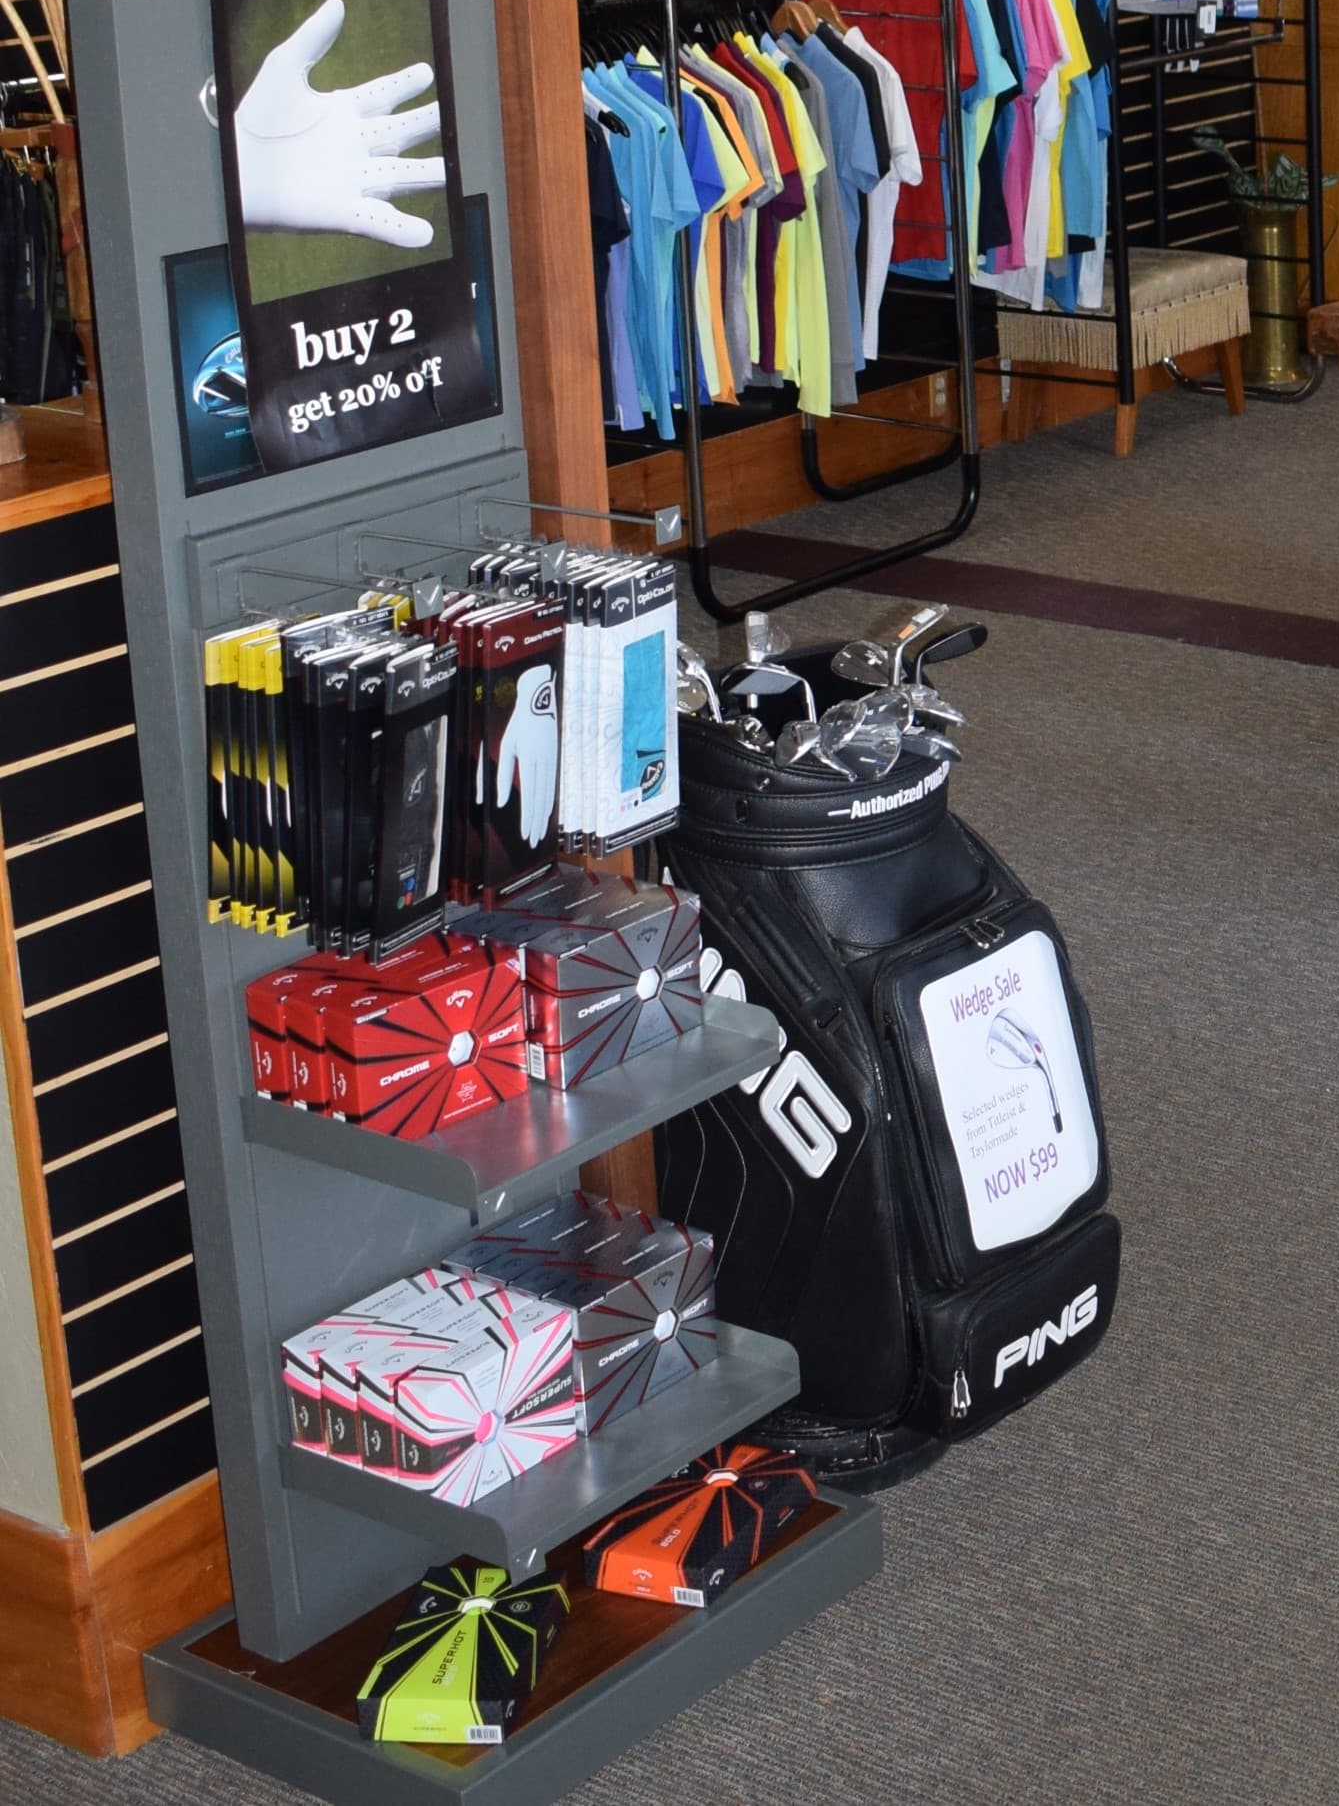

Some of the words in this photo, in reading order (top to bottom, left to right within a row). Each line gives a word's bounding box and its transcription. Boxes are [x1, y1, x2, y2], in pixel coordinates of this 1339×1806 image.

[290, 318, 379, 370] buy
[389, 309, 416, 344] 2
[288, 392, 336, 433] get
[338, 371, 401, 412] 20%
[405, 356, 443, 393] off
[849, 780, 923, 820] Authorized
[577, 993, 622, 1019] CHROME
[950, 985, 995, 1023] Wedge
[994, 968, 1022, 1000] Sale
[488, 1024, 520, 1043] SOFT
[379, 1060, 430, 1086] CHROME
[962, 1094, 997, 1123] Selected
[966, 1123, 987, 1142] from
[1018, 1103, 1027, 1115] &
[984, 1158, 1026, 1203] NOW
[1029, 1142, 1059, 1181] $99
[682, 1298, 709, 1319] SOFT
[598, 1339, 640, 1368] CHROME
[994, 1284, 1098, 1388] PING
[512, 1374, 572, 1420] SUPERSOFT
[660, 1529, 681, 1547] BOLD
[432, 1630, 468, 1685] SUPERHOT
